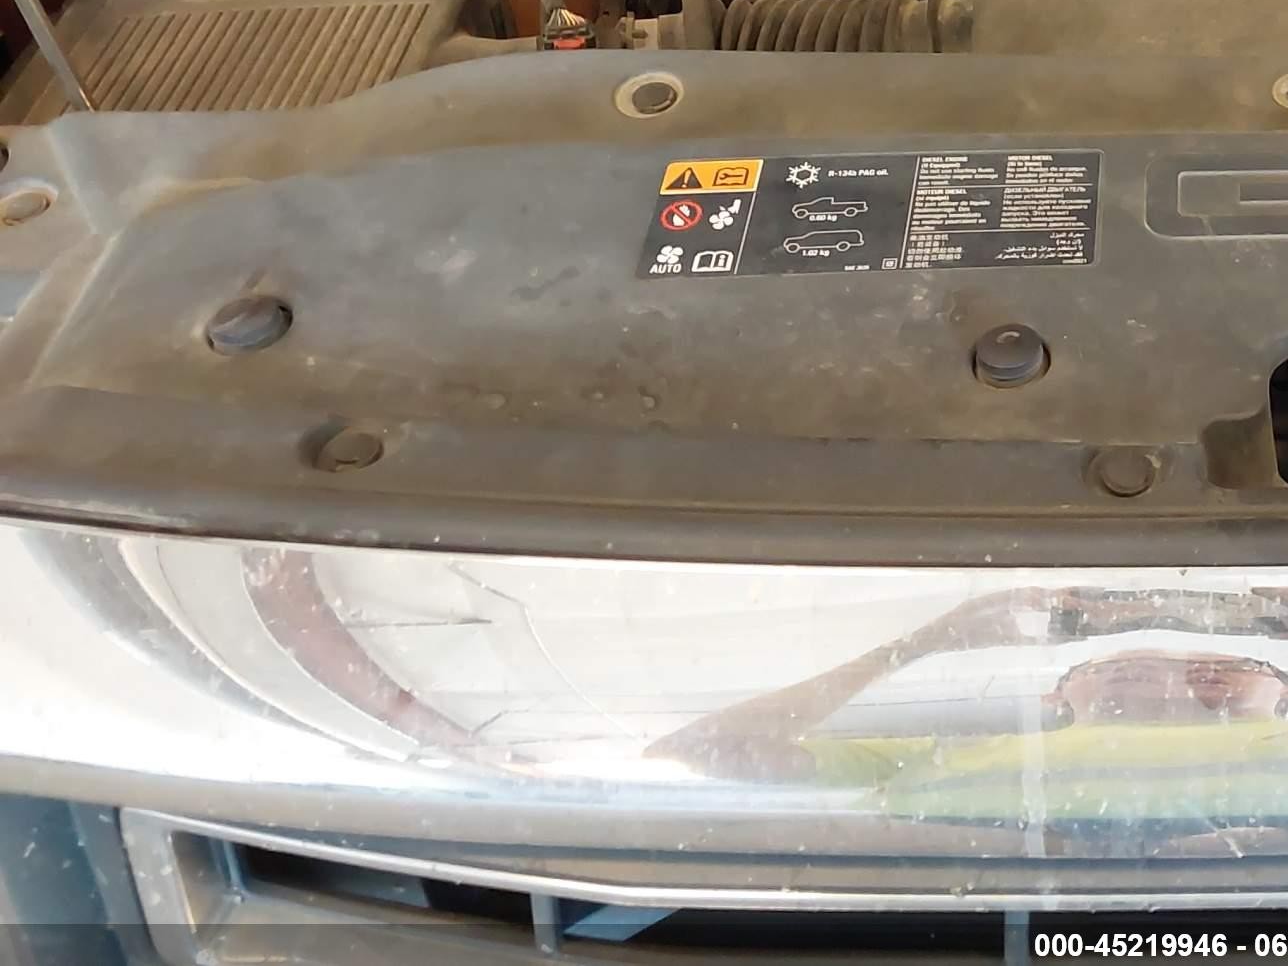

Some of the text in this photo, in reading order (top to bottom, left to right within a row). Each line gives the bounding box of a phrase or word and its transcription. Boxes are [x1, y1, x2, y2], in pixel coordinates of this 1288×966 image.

[827, 215, 838, 223] kg
[819, 250, 831, 258] kg
[649, 263, 683, 274] AUTO
